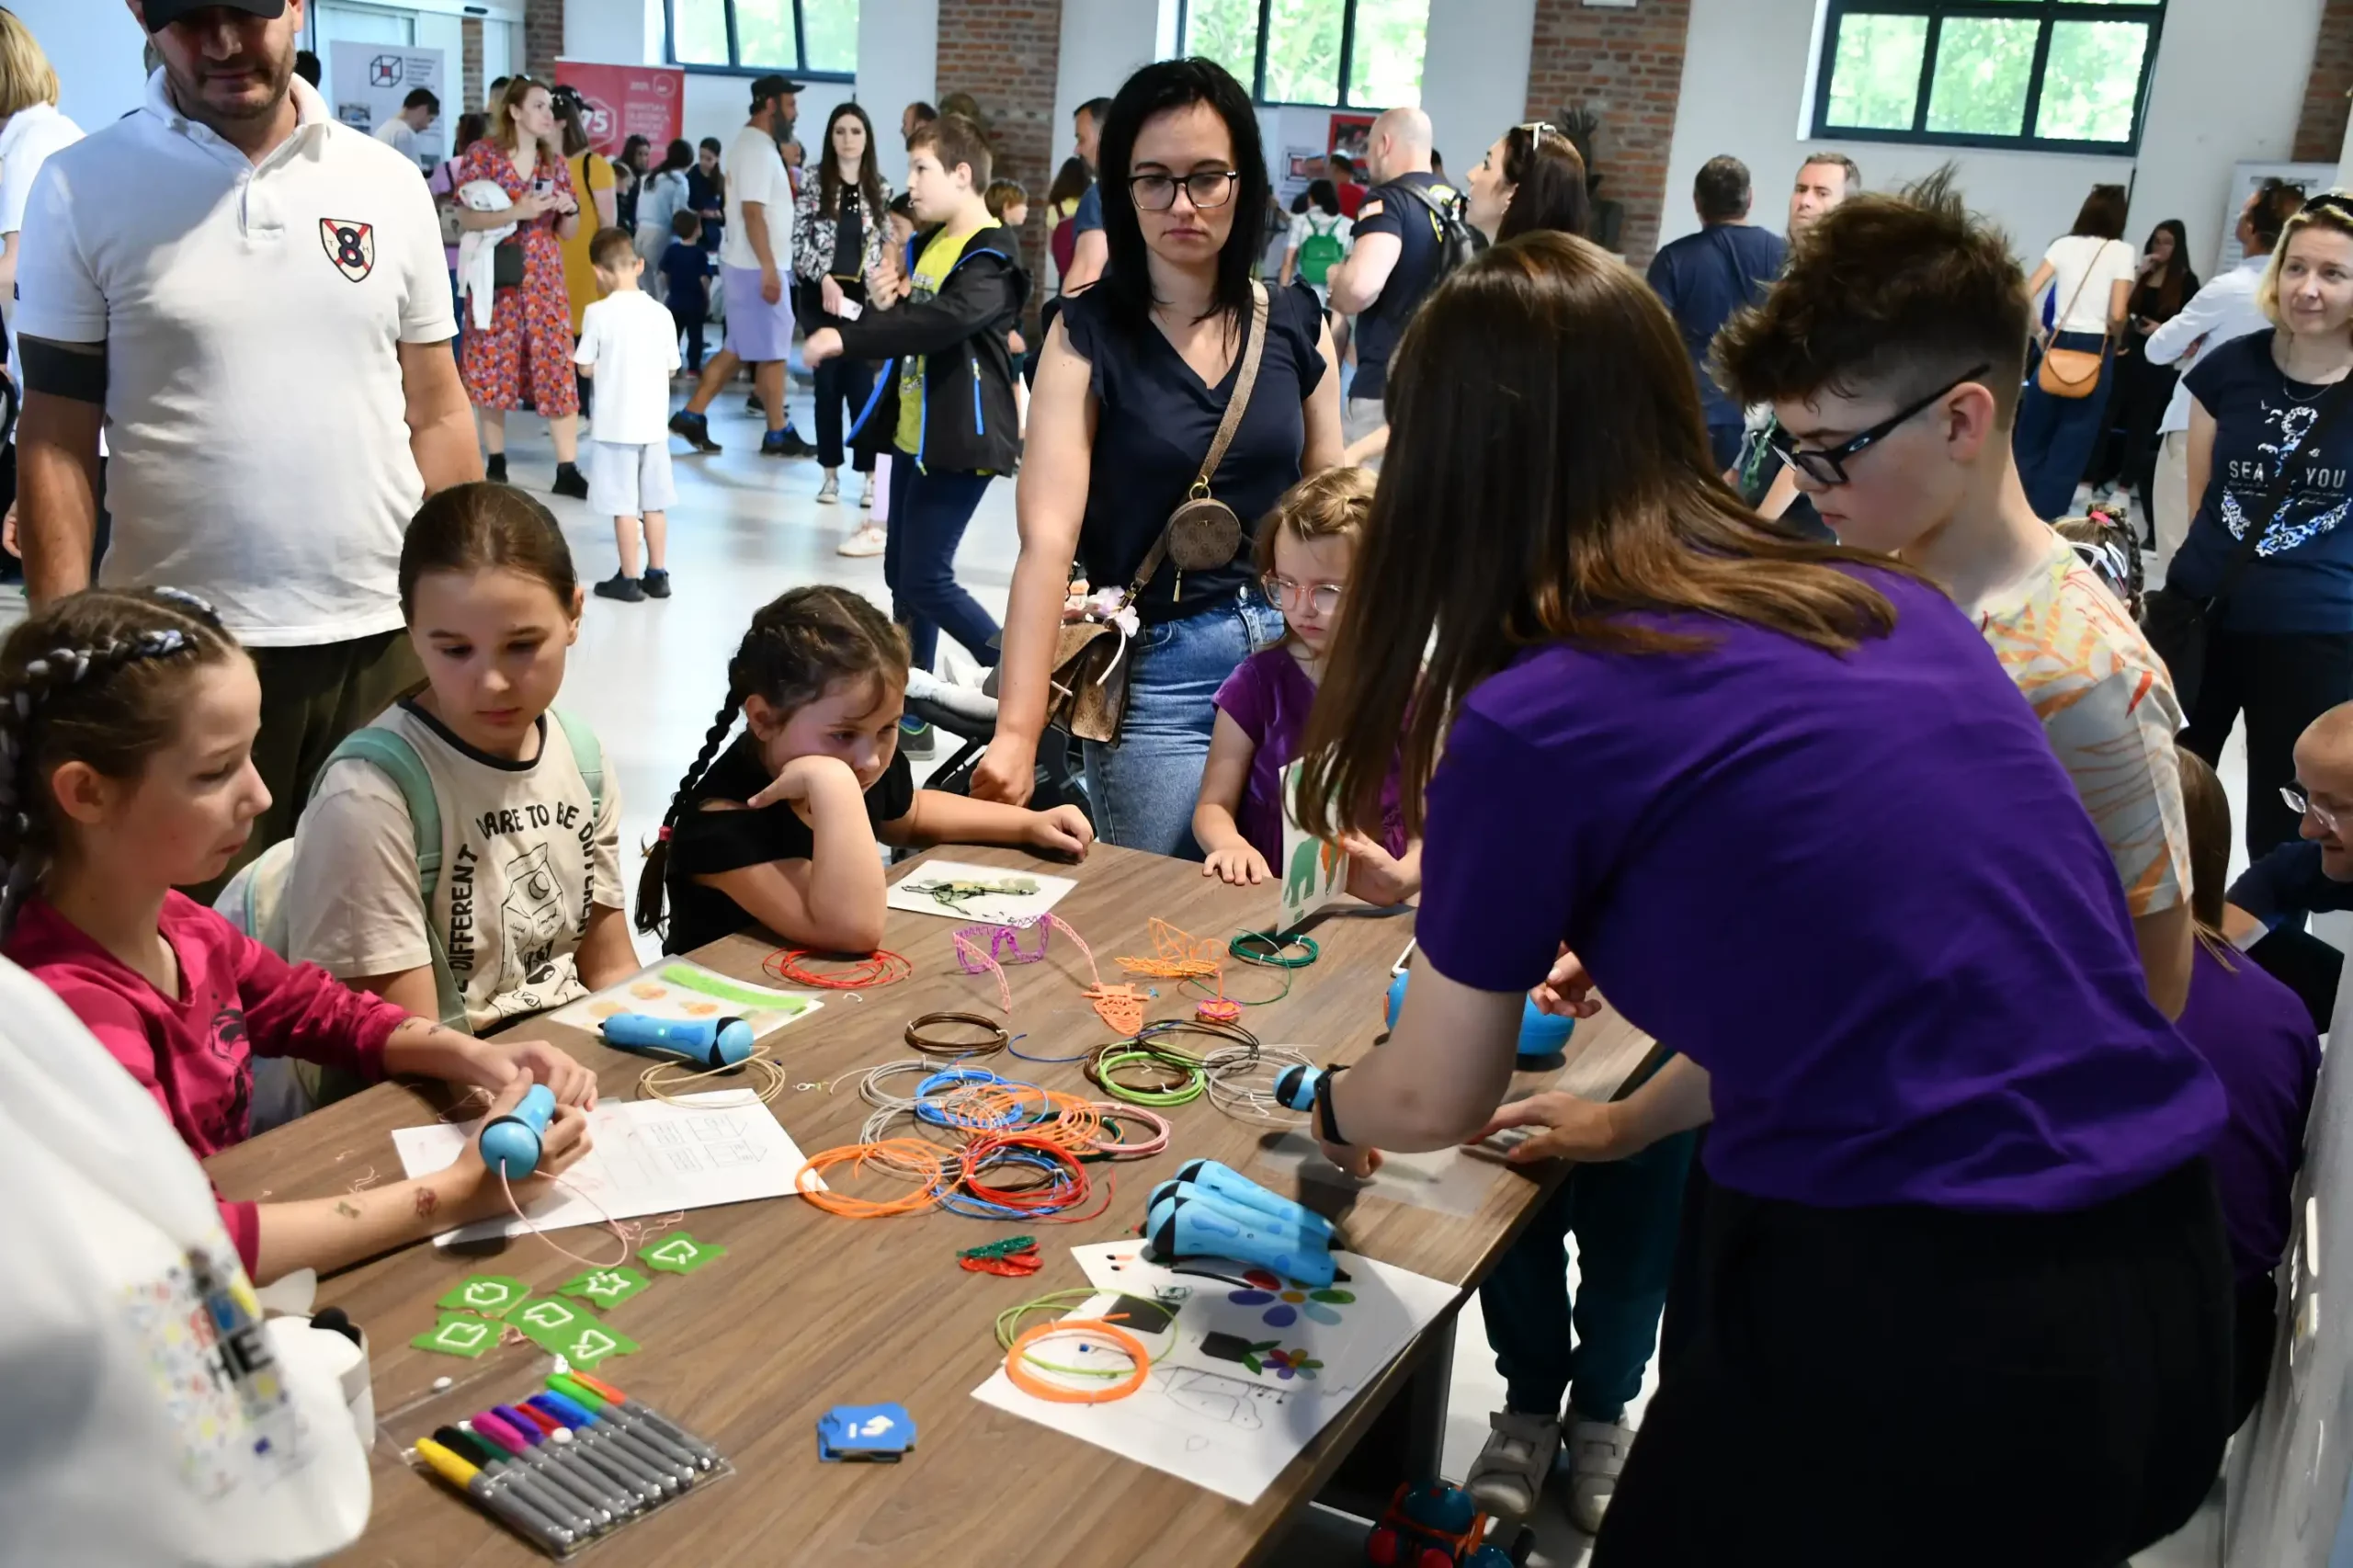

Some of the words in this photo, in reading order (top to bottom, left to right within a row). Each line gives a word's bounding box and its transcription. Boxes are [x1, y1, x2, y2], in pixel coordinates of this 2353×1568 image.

[336, 226, 365, 268] 8
[2228, 460, 2264, 482] SEA
[2305, 467, 2347, 489] YOU
[525, 804, 550, 829] TO
[556, 801, 580, 830] BE
[449, 843, 479, 971] DIFFERENT
